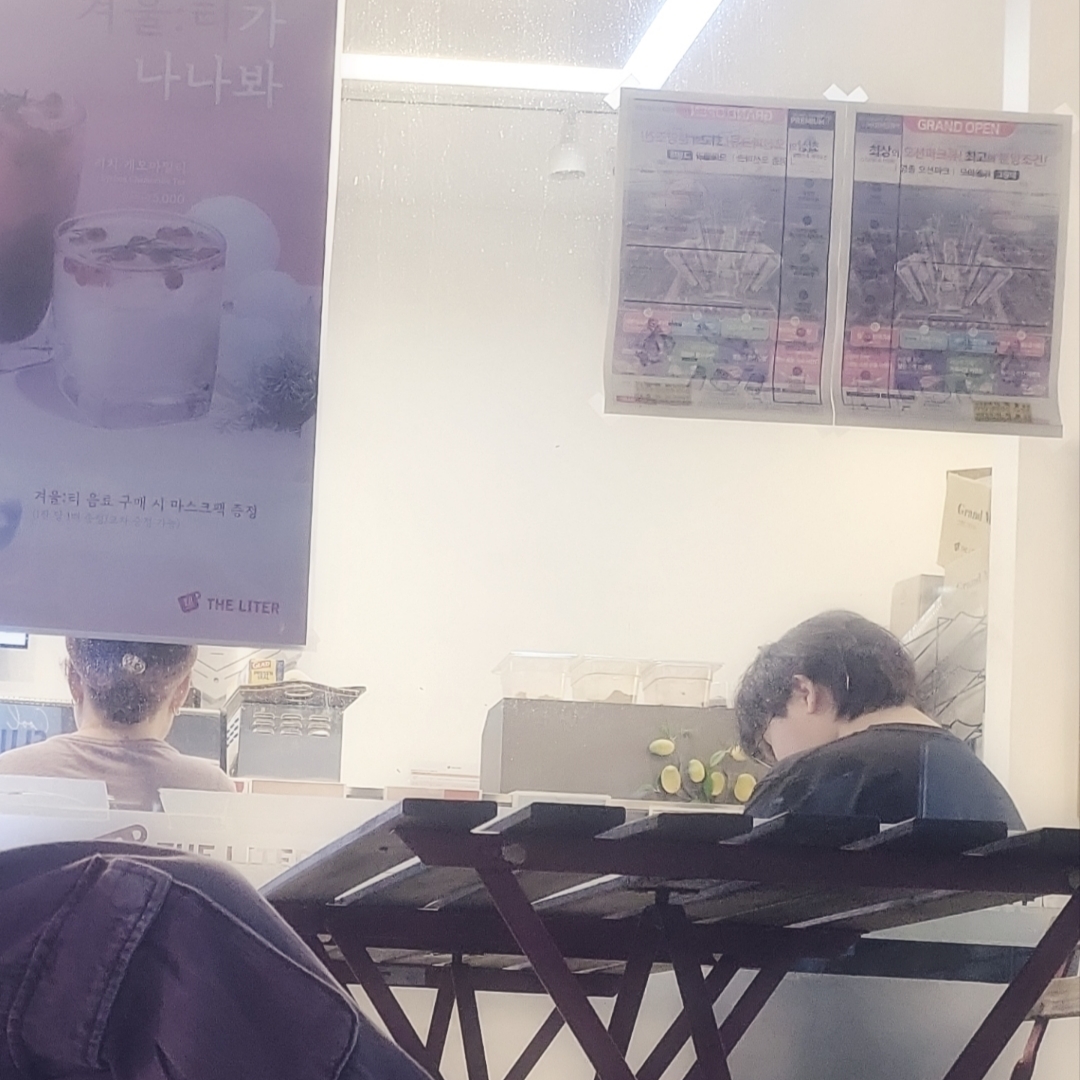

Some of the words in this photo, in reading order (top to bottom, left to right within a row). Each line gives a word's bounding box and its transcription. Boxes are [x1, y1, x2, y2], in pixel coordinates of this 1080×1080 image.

[135, 49, 284, 109] 나나봐
[917, 118, 963, 134] GRAND
[965, 120, 1000, 136] OPEN
[33, 488, 80, 507] 겨울:티
[86, 491, 114, 508] 음료
[118, 494, 146, 511] 구매
[151, 496, 165, 512] 시
[170, 497, 225, 517] 마스크팩
[230, 502, 258, 520] 증정
[957, 503, 983, 523] Grand
[207, 598, 234, 611] THE
[238, 599, 280, 615] LITER
